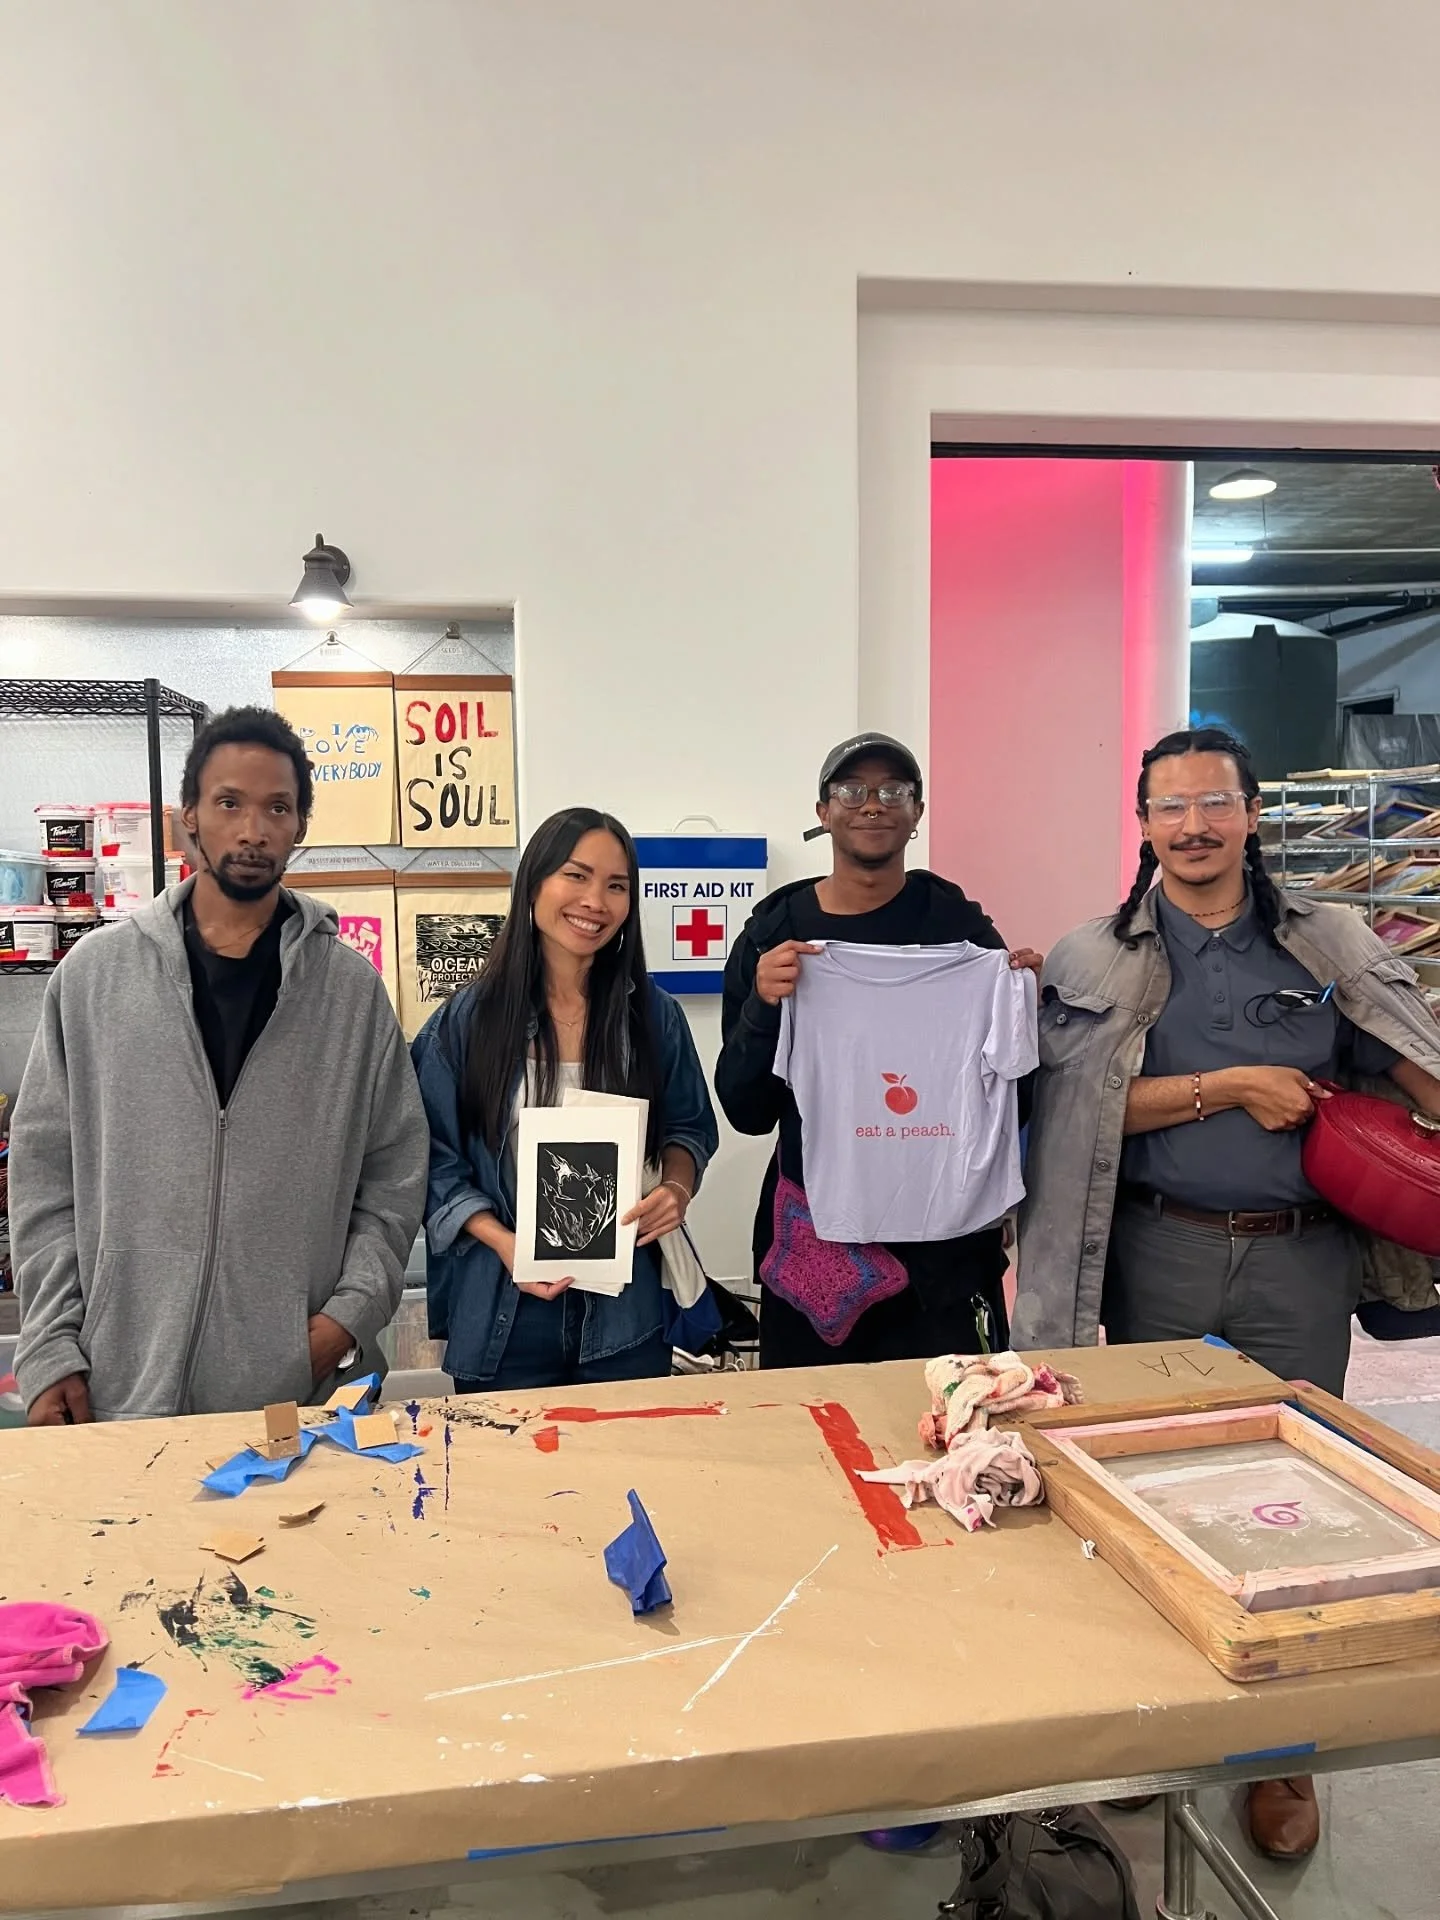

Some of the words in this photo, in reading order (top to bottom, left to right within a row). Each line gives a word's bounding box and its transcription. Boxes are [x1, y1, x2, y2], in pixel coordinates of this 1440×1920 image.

[331, 724, 341, 735] I
[405, 700, 498, 745] SOIL
[313, 762, 382, 781] VERYBODY
[435, 746, 472, 780] IS
[405, 778, 510, 831] SOUL
[644, 883, 688, 898] FIRST
[692, 883, 724, 898] AID
[730, 882, 755, 898] KIT
[432, 973, 473, 981] PROTECT
[855, 1124, 882, 1137] eat
[886, 1126, 896, 1137] a
[901, 1123, 955, 1140] peach.
